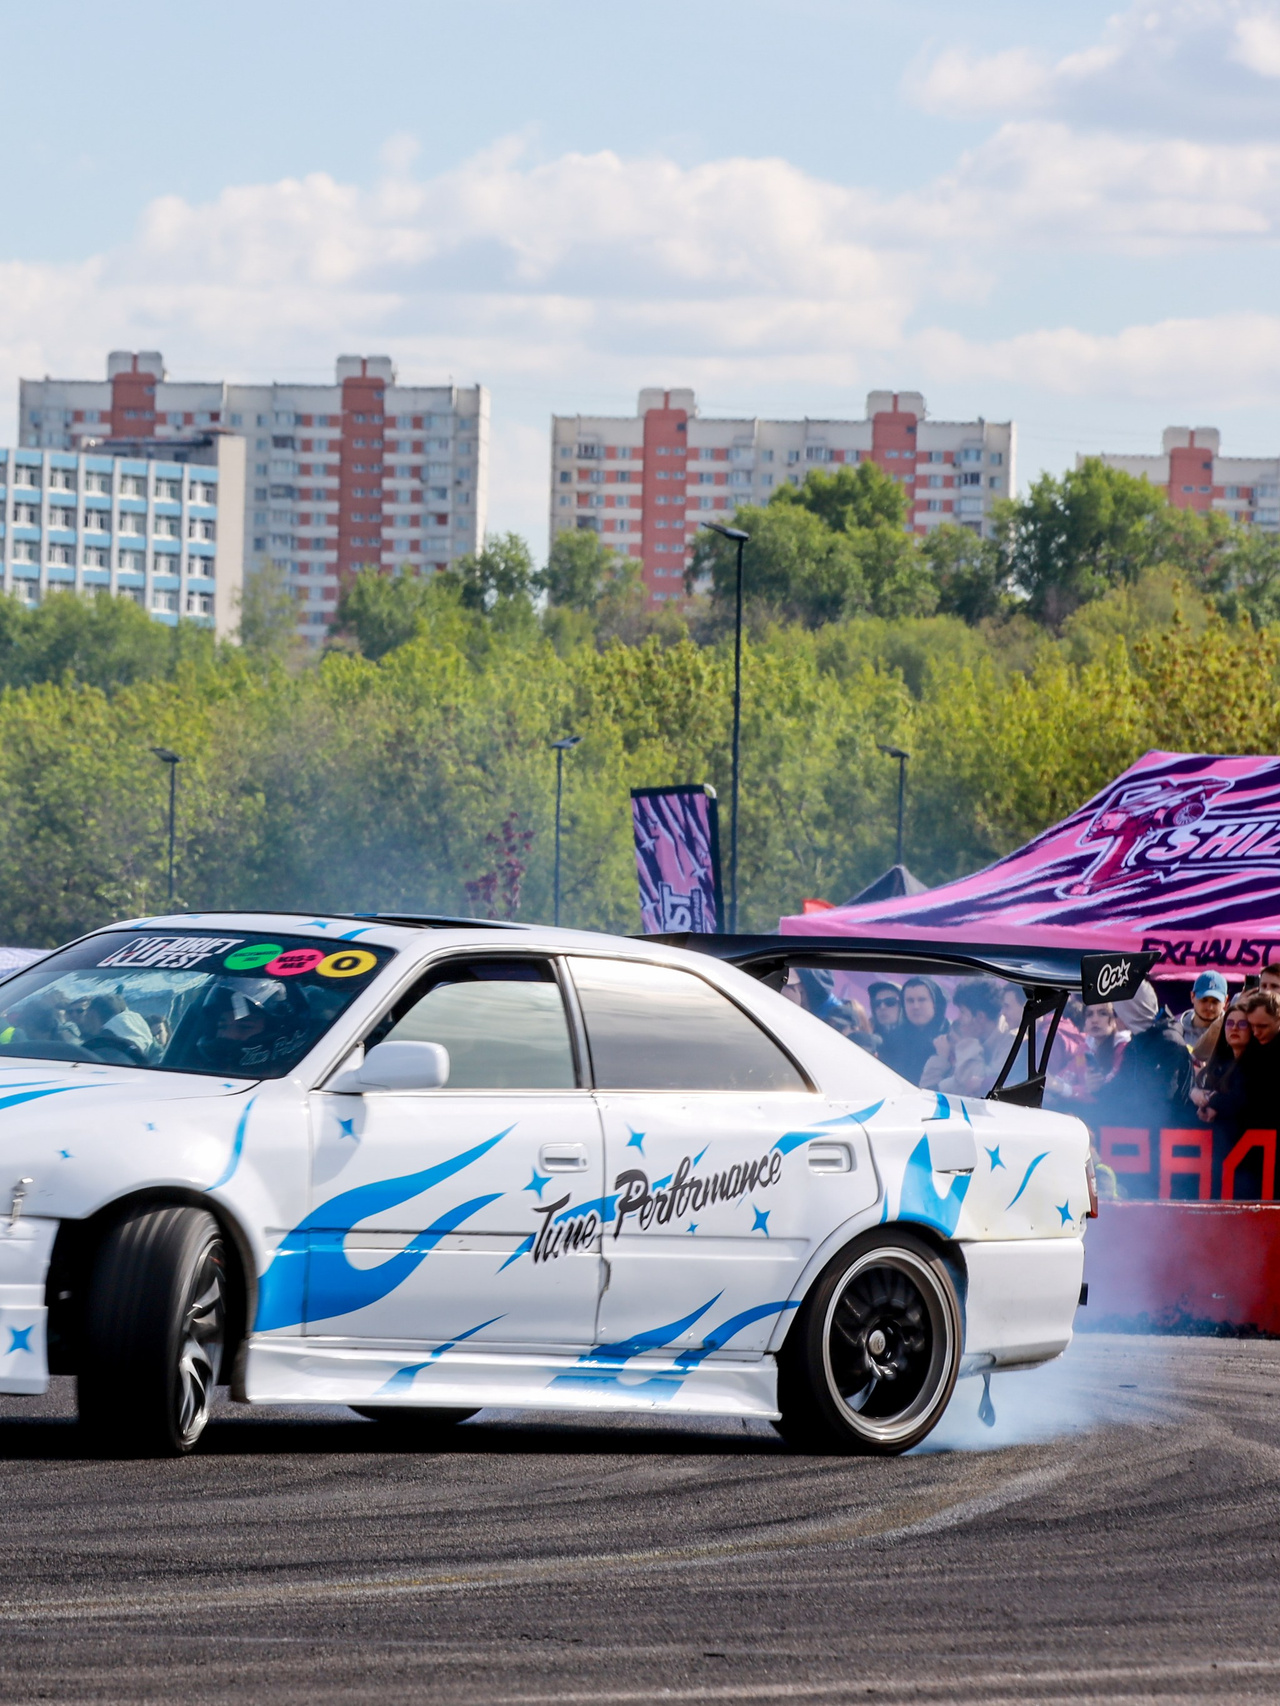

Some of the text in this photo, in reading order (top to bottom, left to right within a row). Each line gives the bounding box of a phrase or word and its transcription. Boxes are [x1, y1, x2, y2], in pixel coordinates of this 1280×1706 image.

[166, 937, 246, 955] DRIFT
[152, 952, 214, 969] FEST
[276, 954, 318, 963] KISS
[532, 1151, 783, 1263] Tune Performance
